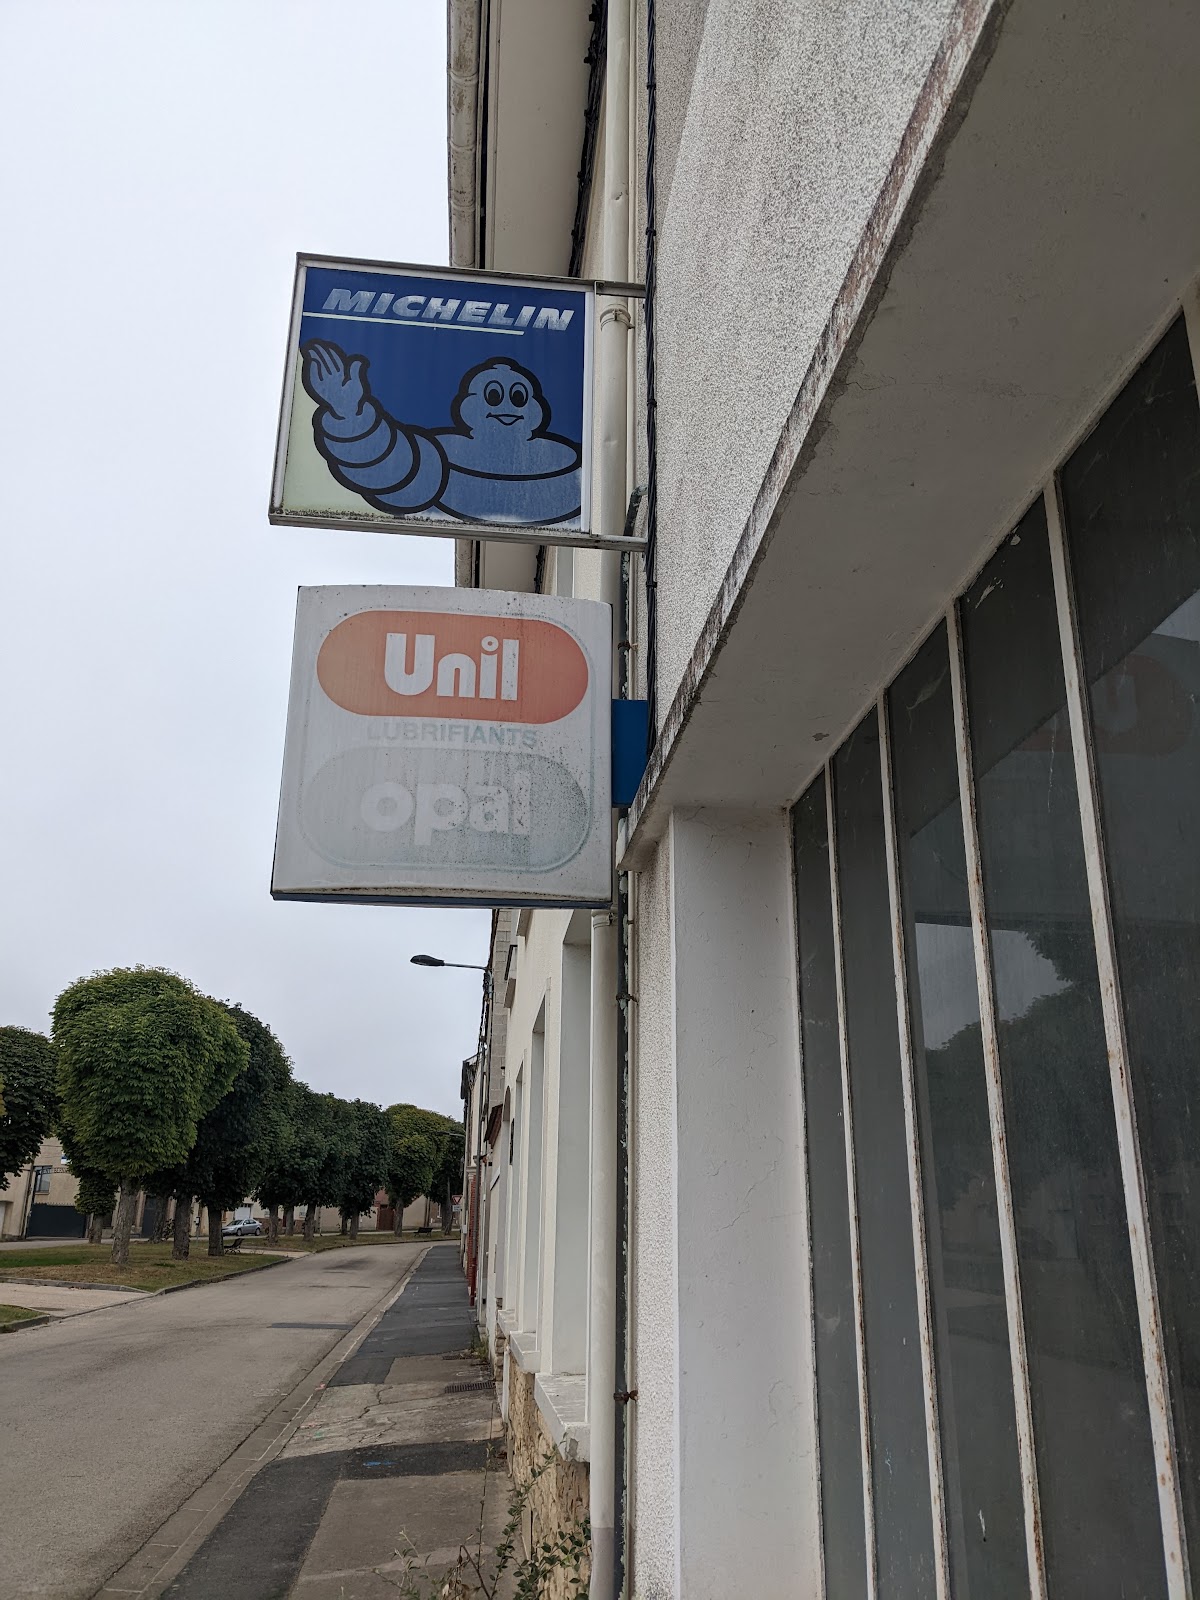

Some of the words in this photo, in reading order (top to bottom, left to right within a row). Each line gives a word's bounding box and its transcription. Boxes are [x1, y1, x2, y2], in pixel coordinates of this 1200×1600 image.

[322, 288, 575, 331] MICHELIN
[384, 632, 520, 701] Unil
[366, 721, 539, 747] LUBRIFIANTS
[360, 769, 532, 846] opal
